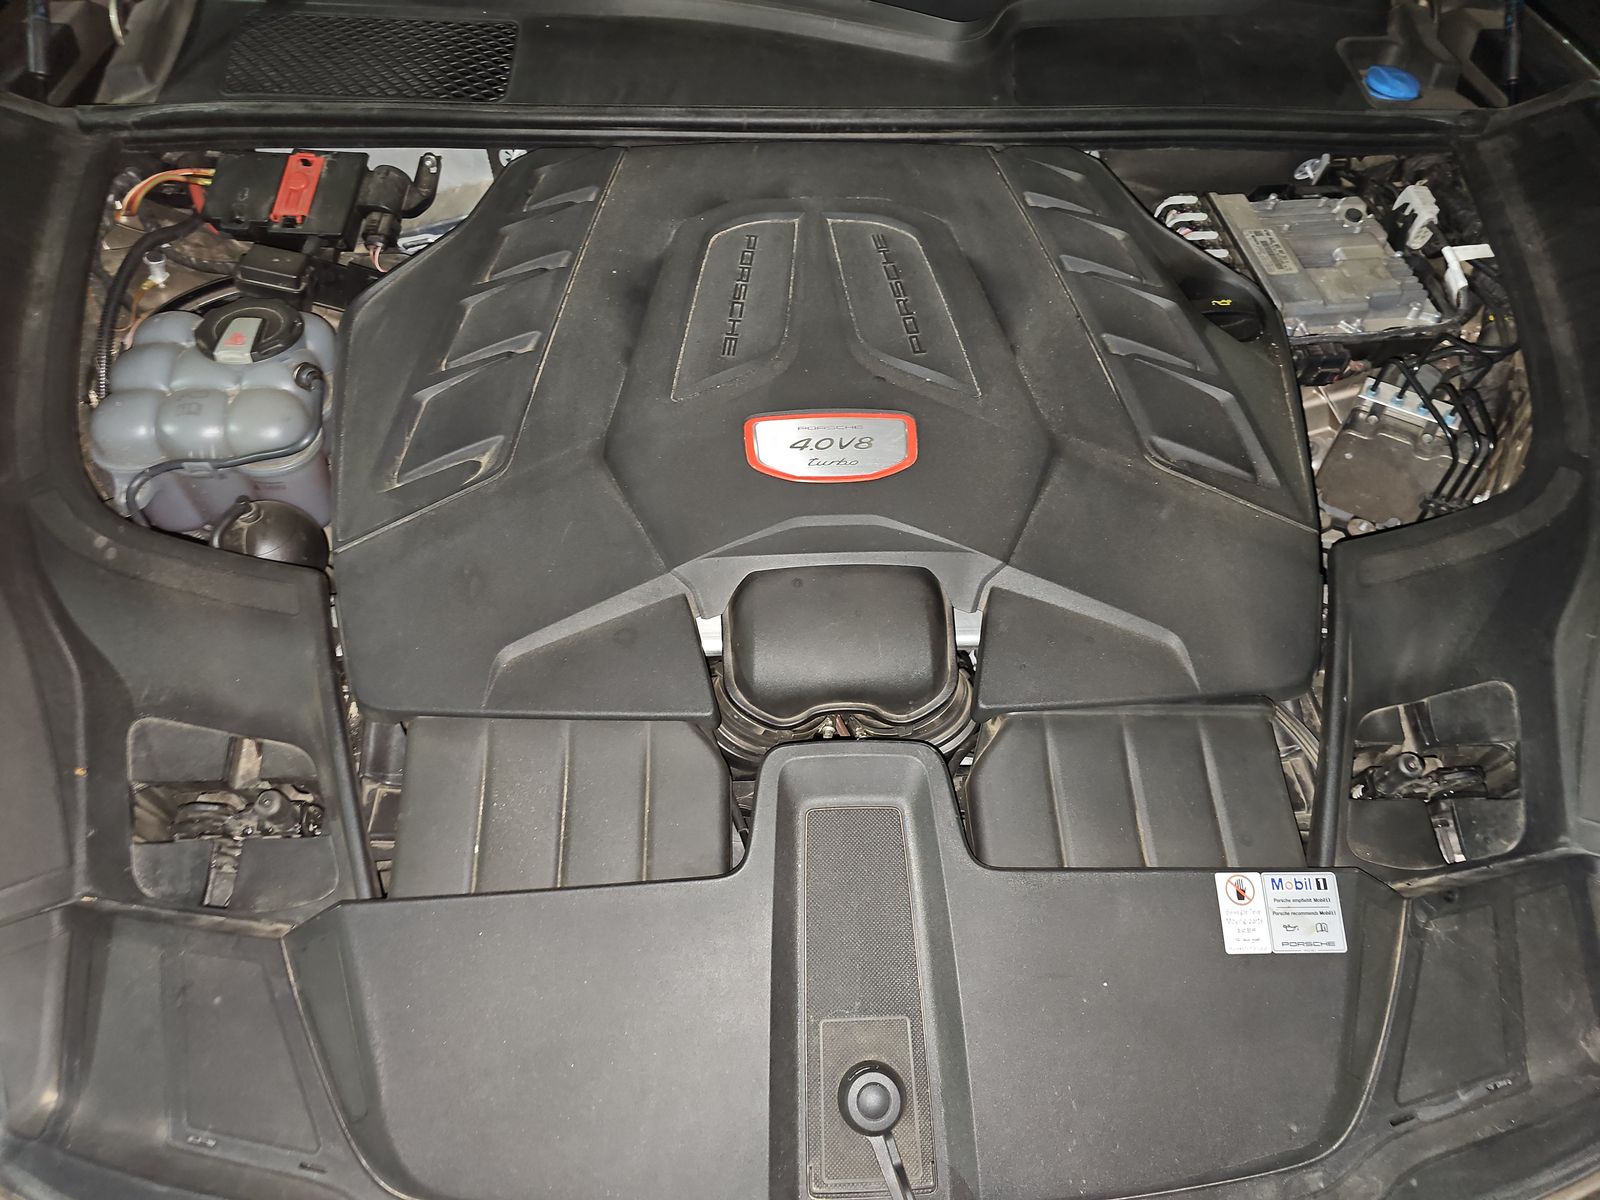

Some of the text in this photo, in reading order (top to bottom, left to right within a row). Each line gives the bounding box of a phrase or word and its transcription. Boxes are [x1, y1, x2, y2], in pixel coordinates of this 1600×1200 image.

[721, 234, 758, 357] PORSCHE
[871, 233, 926, 355] PORSCHE
[807, 457, 859, 466] turbo
[1271, 878, 1328, 890] Mobil 1
